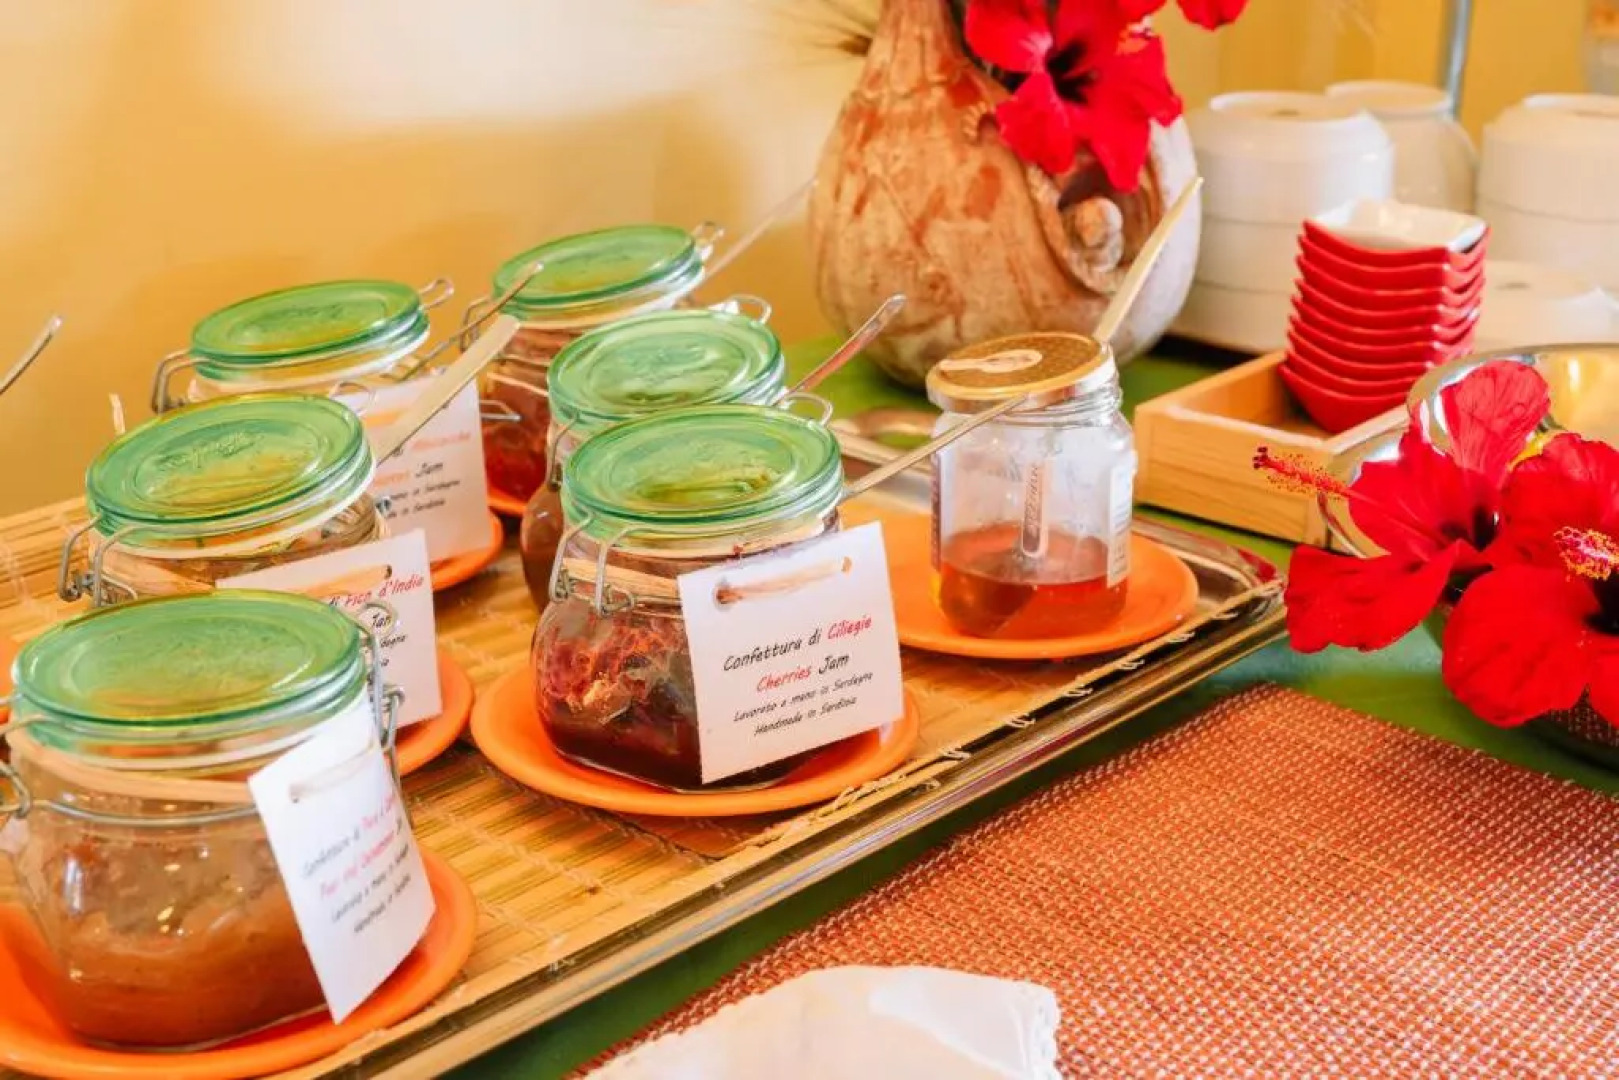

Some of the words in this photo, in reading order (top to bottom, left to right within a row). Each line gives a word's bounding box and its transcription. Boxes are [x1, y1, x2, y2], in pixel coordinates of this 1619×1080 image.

[345, 590, 372, 606] Fico
[379, 573, 424, 597] d'India
[723, 638, 802, 671] Confettura
[808, 627, 822, 645] di
[756, 666, 811, 692] Cherries
[818, 654, 850, 674] Jam
[754, 711, 803, 736] Handmade
